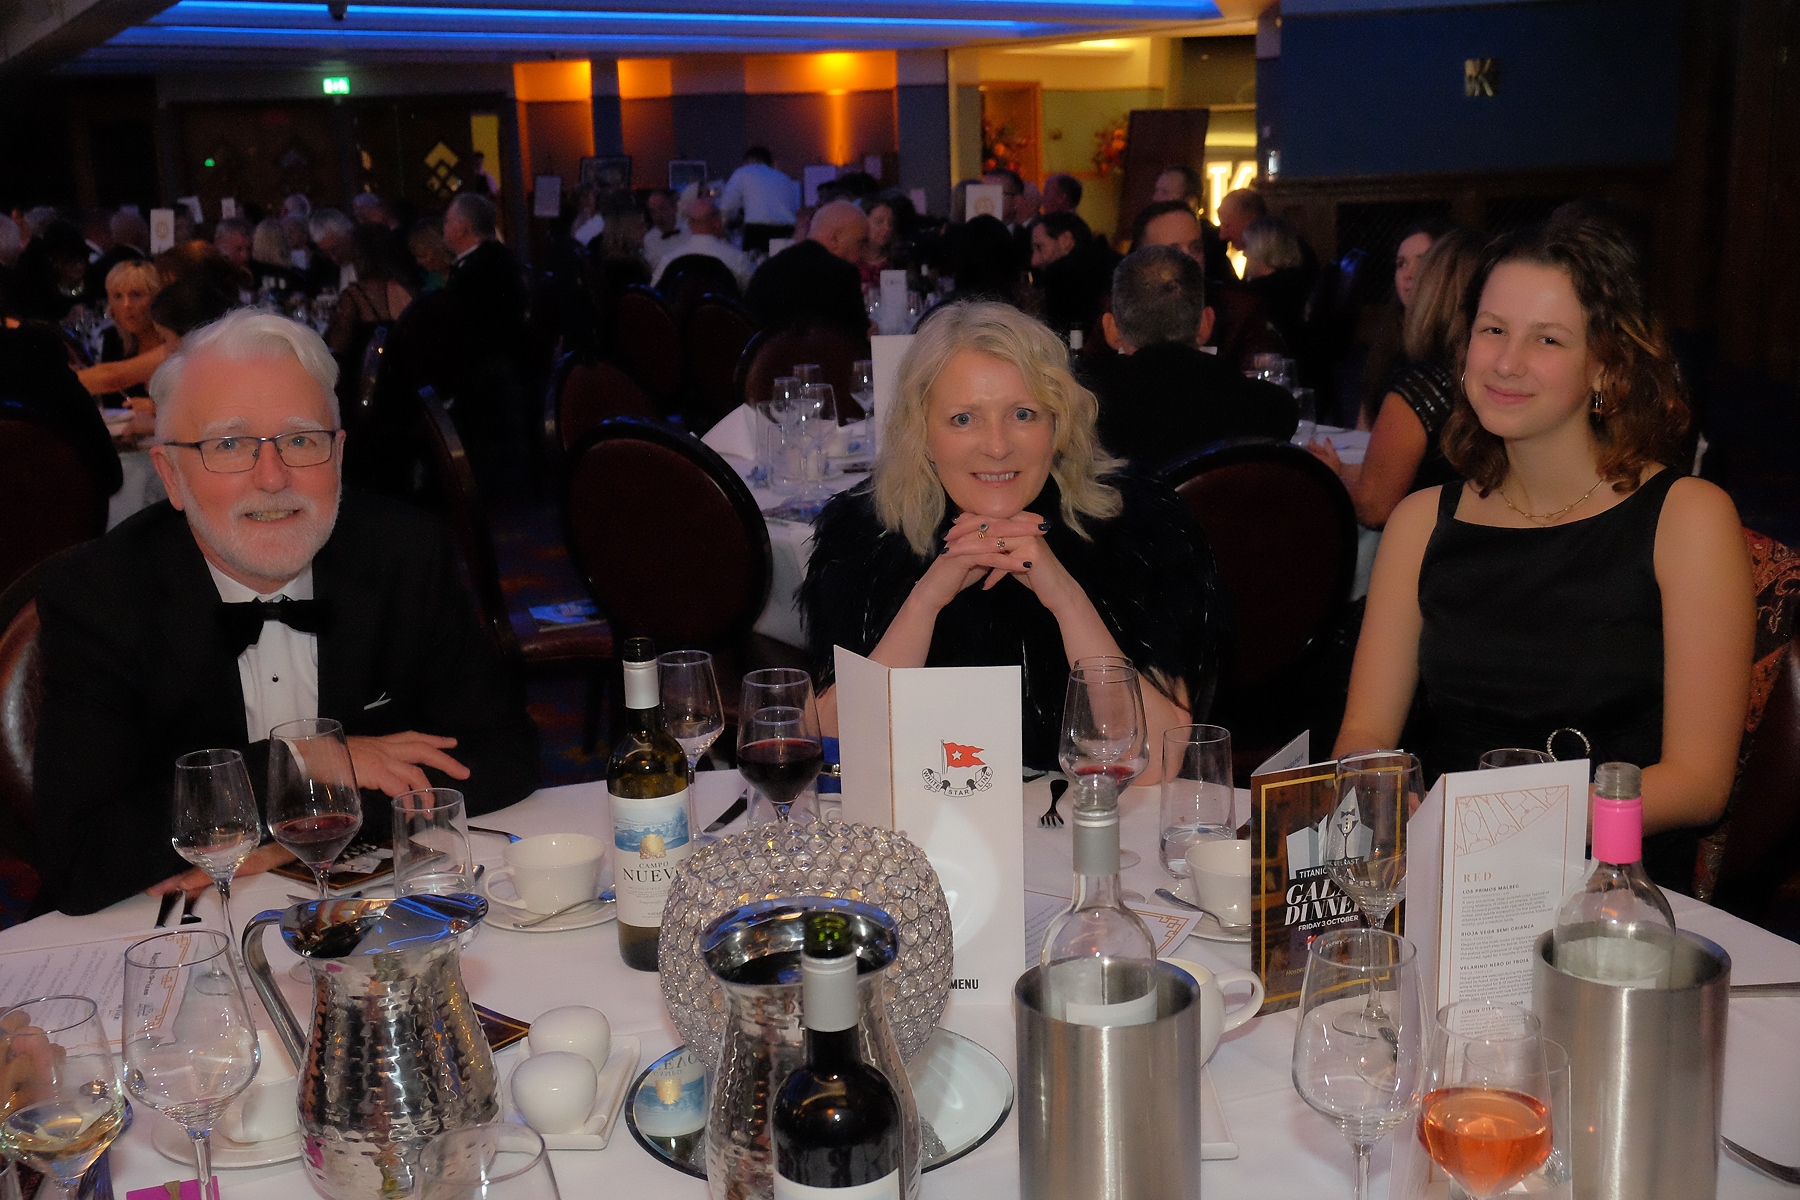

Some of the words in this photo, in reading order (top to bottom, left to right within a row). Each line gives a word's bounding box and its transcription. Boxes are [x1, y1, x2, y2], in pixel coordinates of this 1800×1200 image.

[923, 770, 941, 790] WHITE
[977, 771, 992, 788] LINE
[638, 861, 669, 869] CAMPO
[1299, 867, 1328, 879] TITANIC
[1463, 872, 1491, 882] RED
[1298, 922, 1322, 932] FRIDAY
[1327, 915, 1359, 926] OCTOBER
[950, 979, 979, 990] MENU
